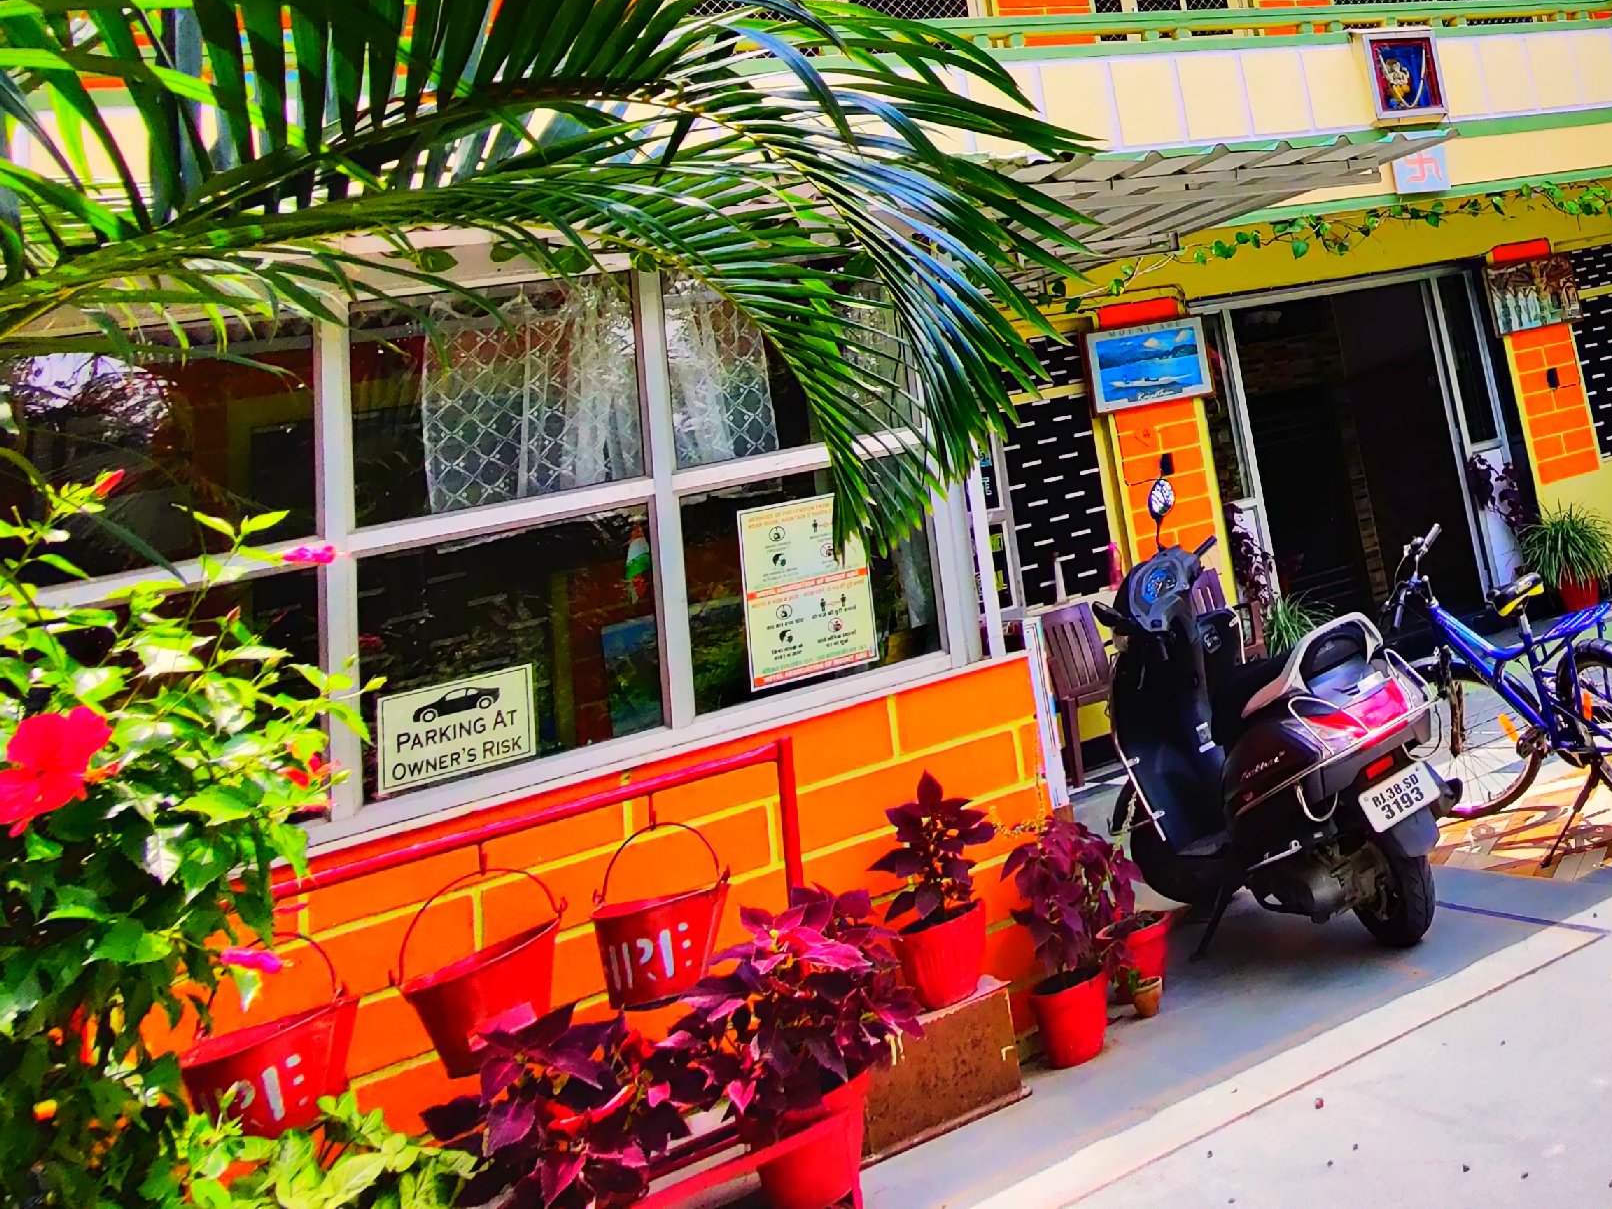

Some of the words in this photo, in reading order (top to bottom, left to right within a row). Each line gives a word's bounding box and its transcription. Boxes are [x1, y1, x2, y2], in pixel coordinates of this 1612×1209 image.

[396, 717, 486, 753] PARKING
[493, 709, 518, 731] AT
[392, 747, 477, 781] OWNER'S
[482, 735, 523, 759] RISK
[1381, 787, 1424, 819] 3193
[608, 922, 693, 992] IRE
